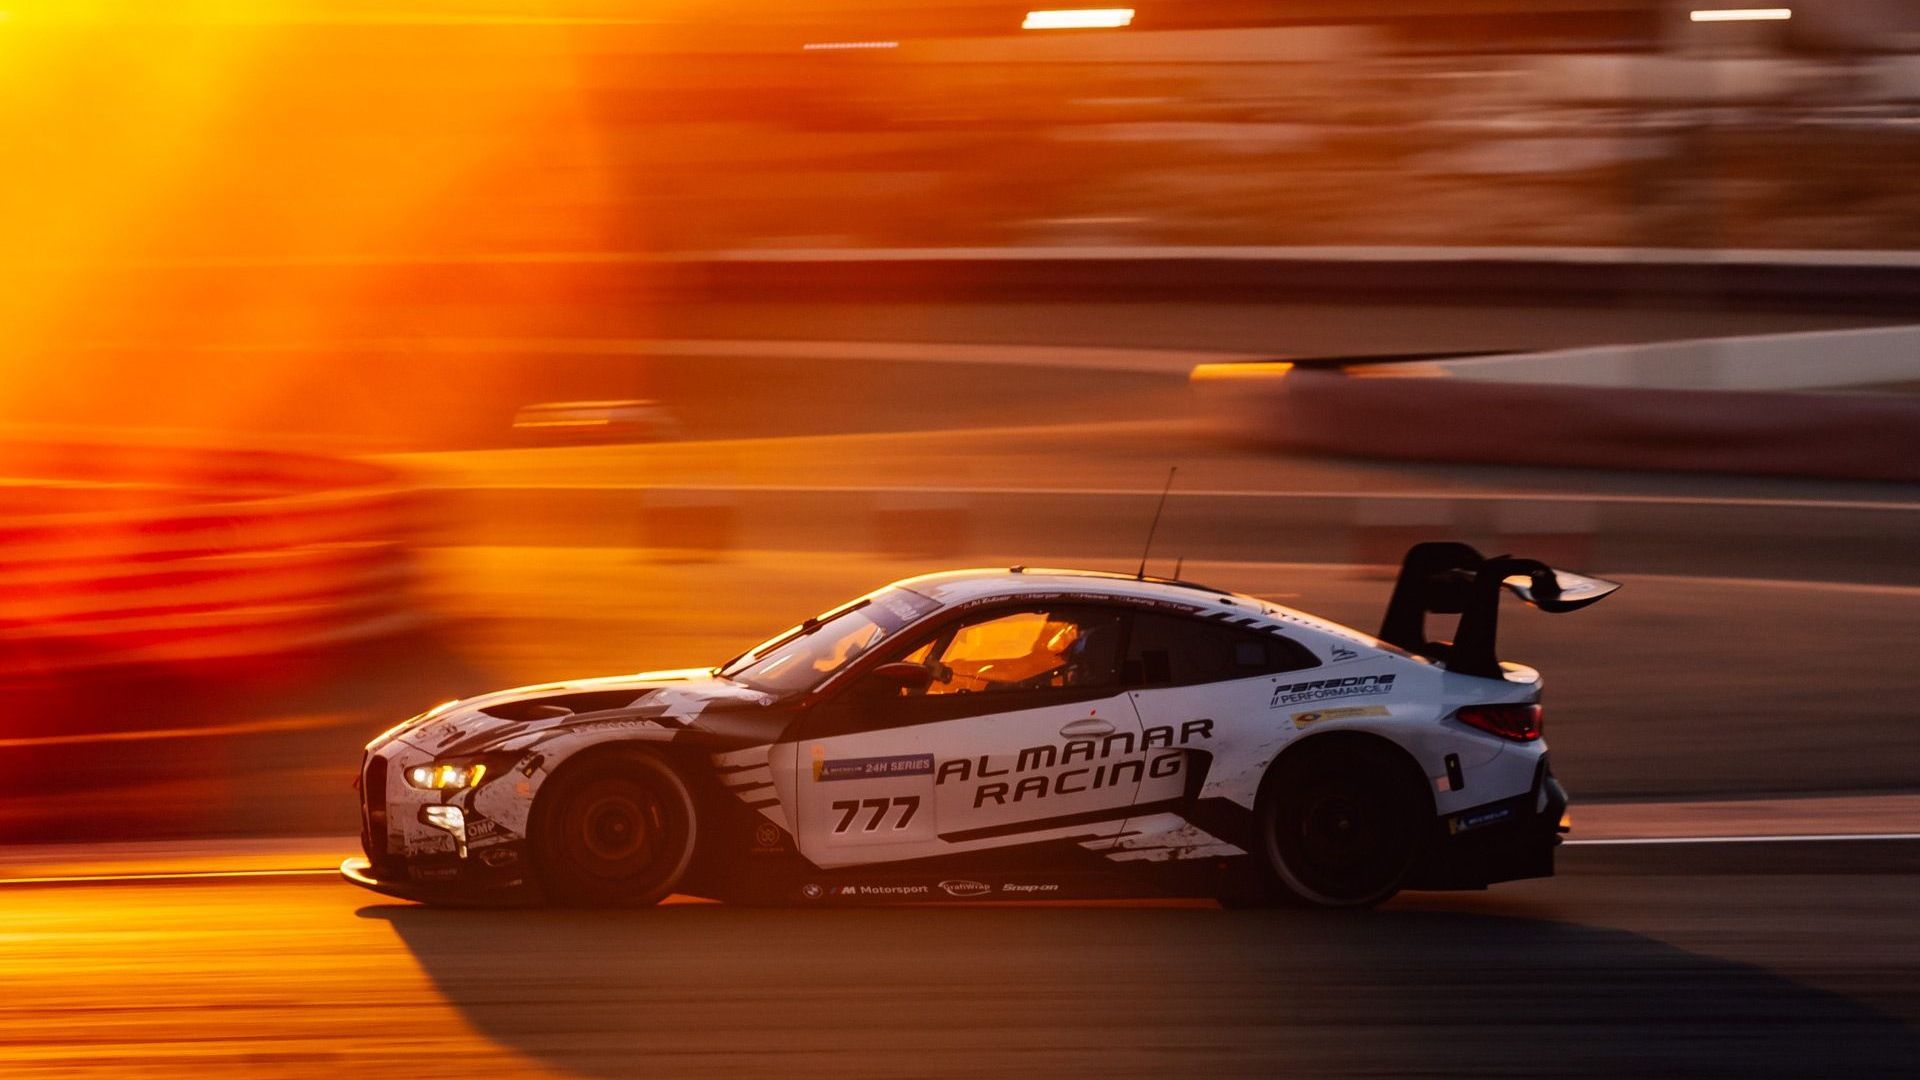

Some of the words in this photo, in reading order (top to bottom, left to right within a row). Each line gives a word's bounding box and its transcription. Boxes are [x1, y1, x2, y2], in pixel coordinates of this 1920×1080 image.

[933, 718, 1214, 785] ALMANAR
[864, 763, 887, 773] 24H
[890, 759, 930, 771] SERIES
[973, 750, 1181, 808] RACING
[832, 796, 920, 834] 777
[468, 820, 496, 836] OMP
[860, 884, 928, 894] Motorsport
[1002, 883, 1059, 893] Snap-on
